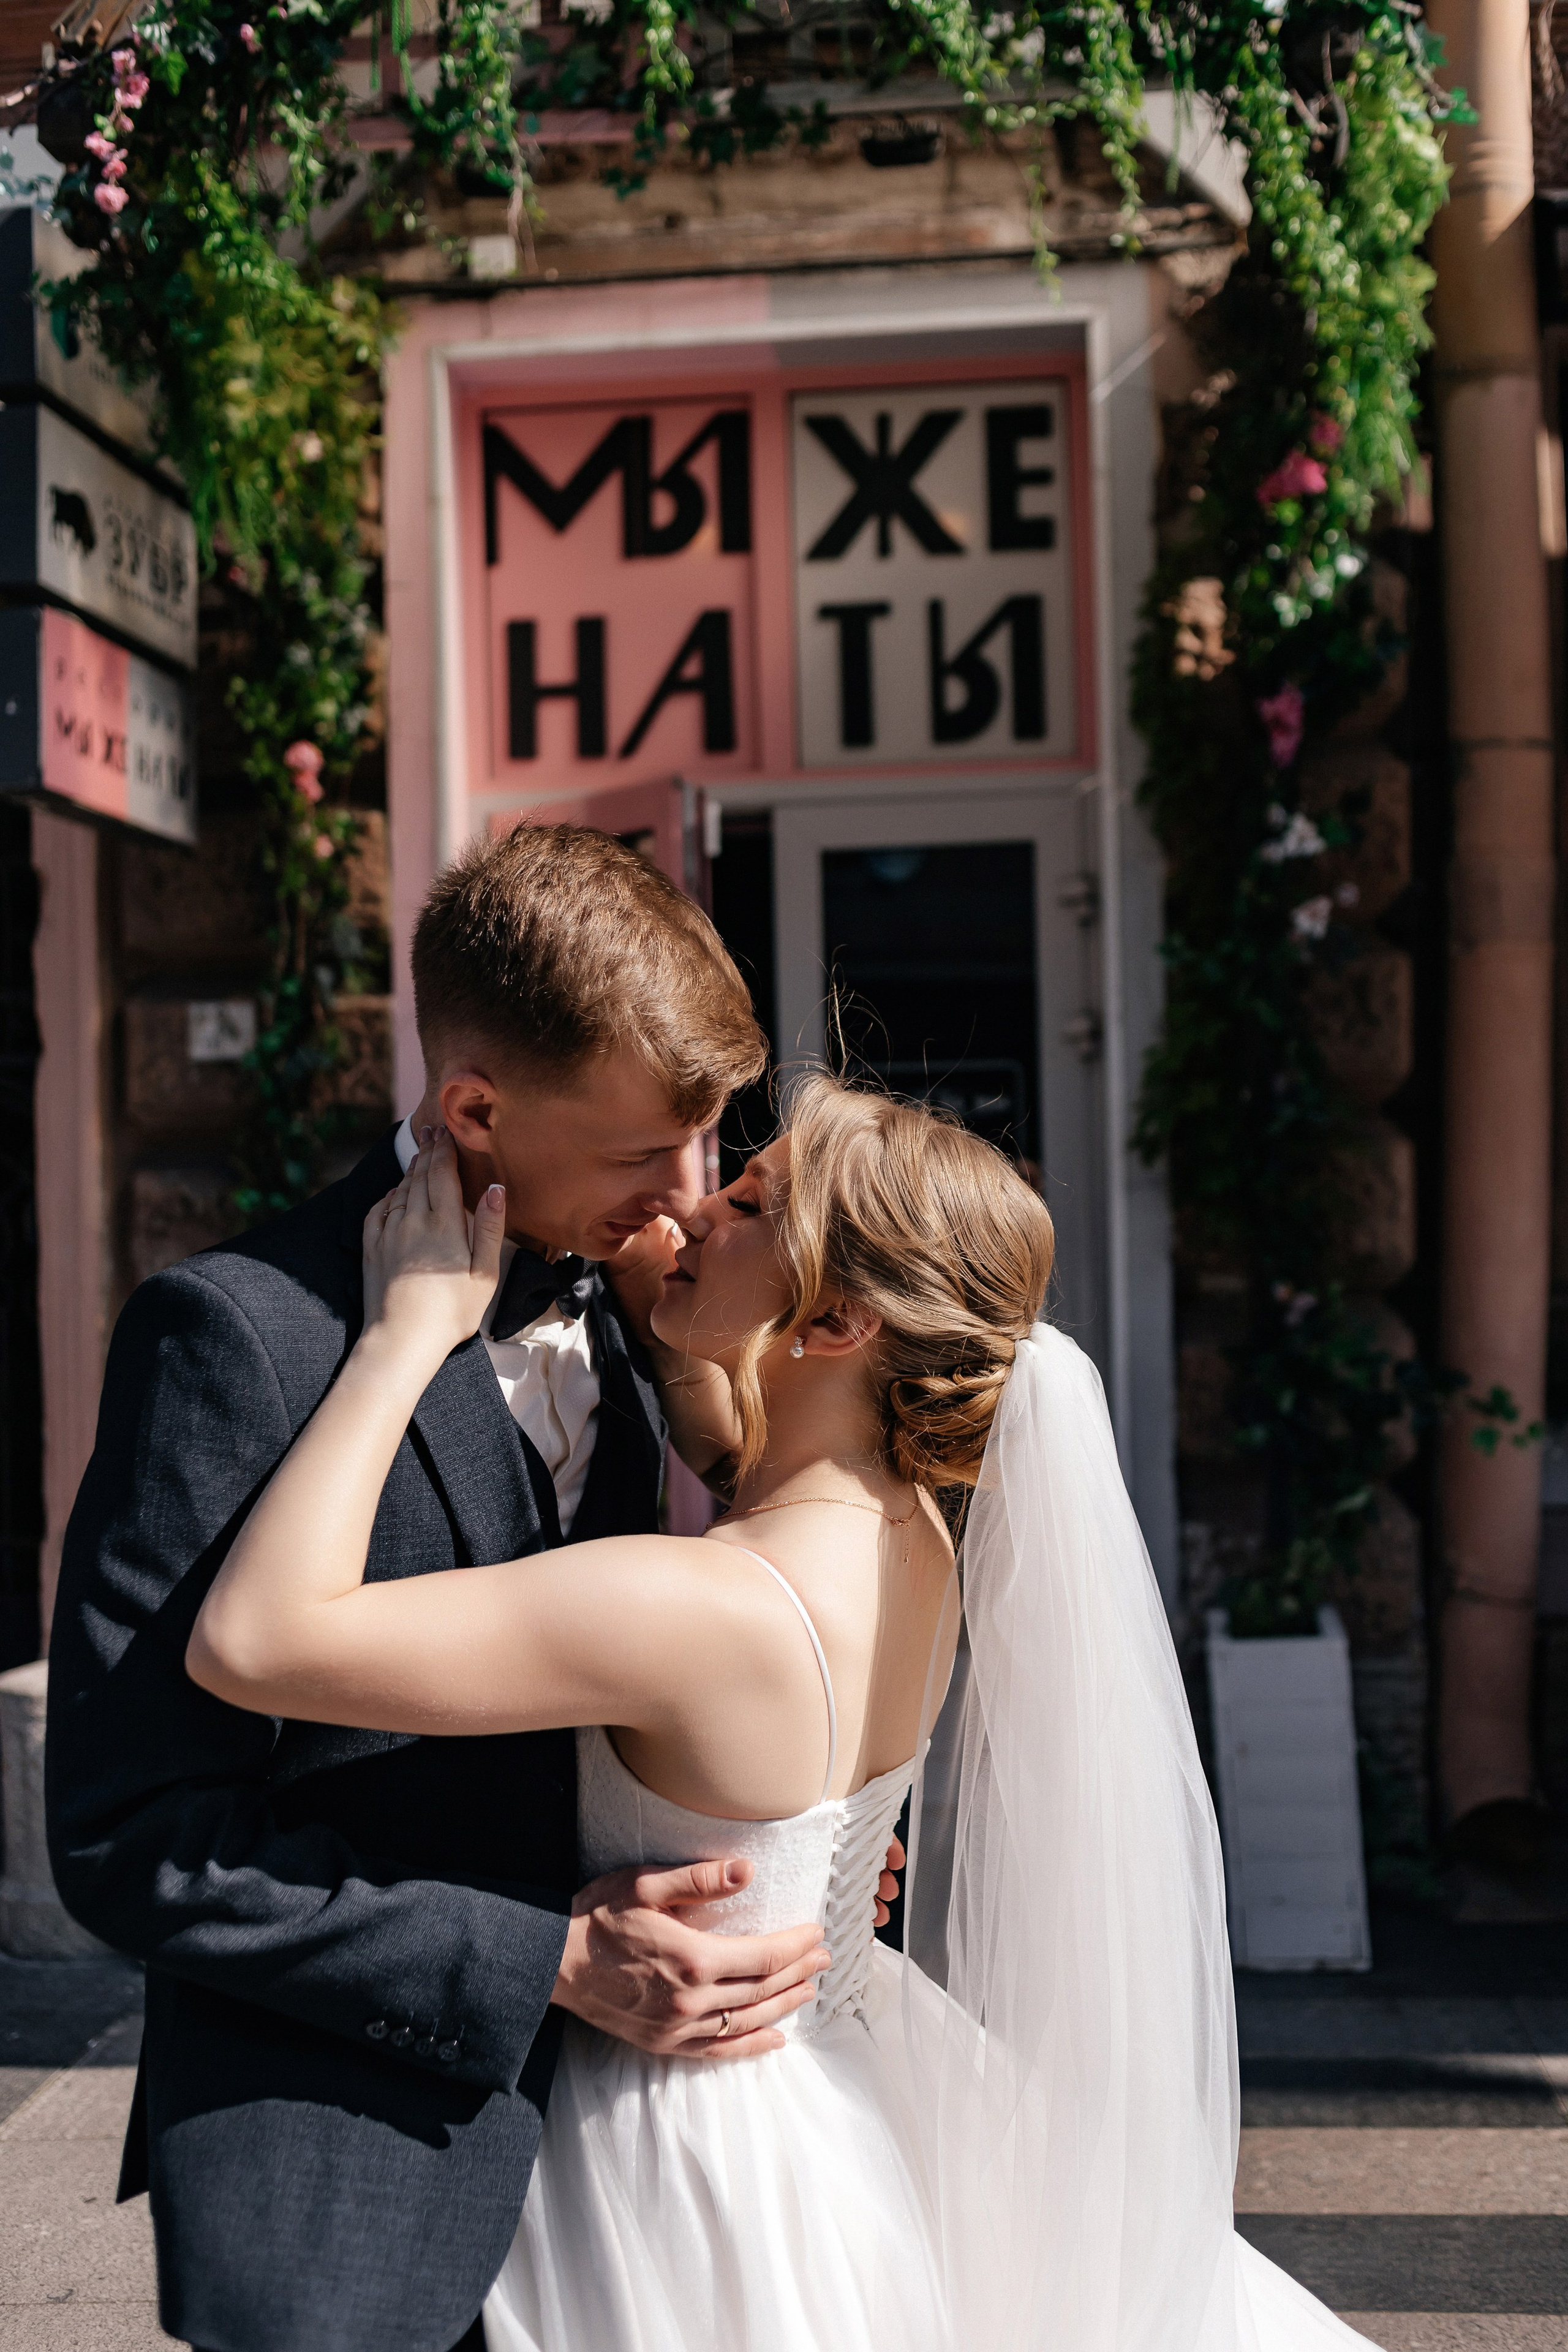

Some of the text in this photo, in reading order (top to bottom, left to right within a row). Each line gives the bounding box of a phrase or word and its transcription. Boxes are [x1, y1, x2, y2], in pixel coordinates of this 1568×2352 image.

[802, 404, 1055, 561] ЖЕ
[507, 593, 1049, 761] НА ТЫ
